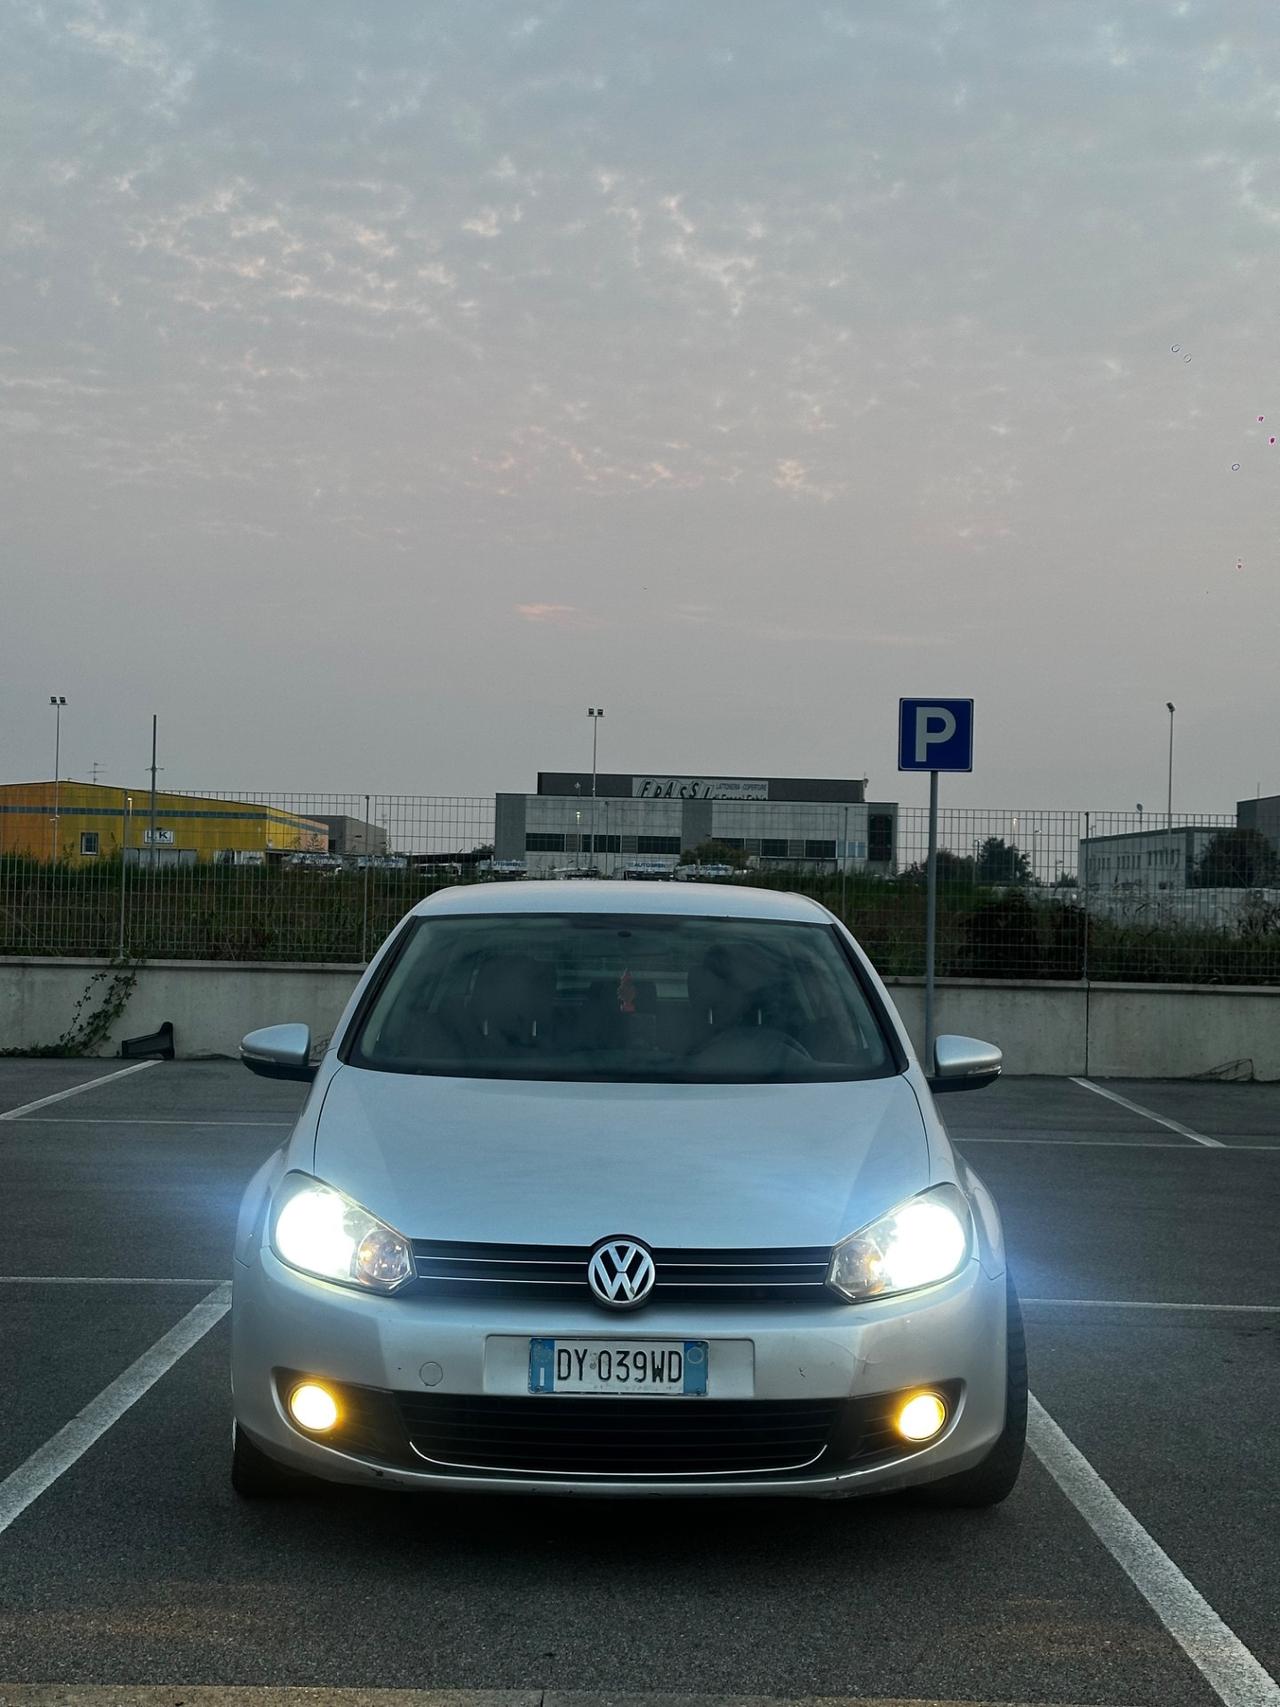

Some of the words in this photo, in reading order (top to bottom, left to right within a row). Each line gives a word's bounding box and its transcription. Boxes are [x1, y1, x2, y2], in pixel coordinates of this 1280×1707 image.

[915, 706, 956, 762] P
[557, 1349, 588, 1381] DY
[598, 1350, 682, 1383] 039WD
